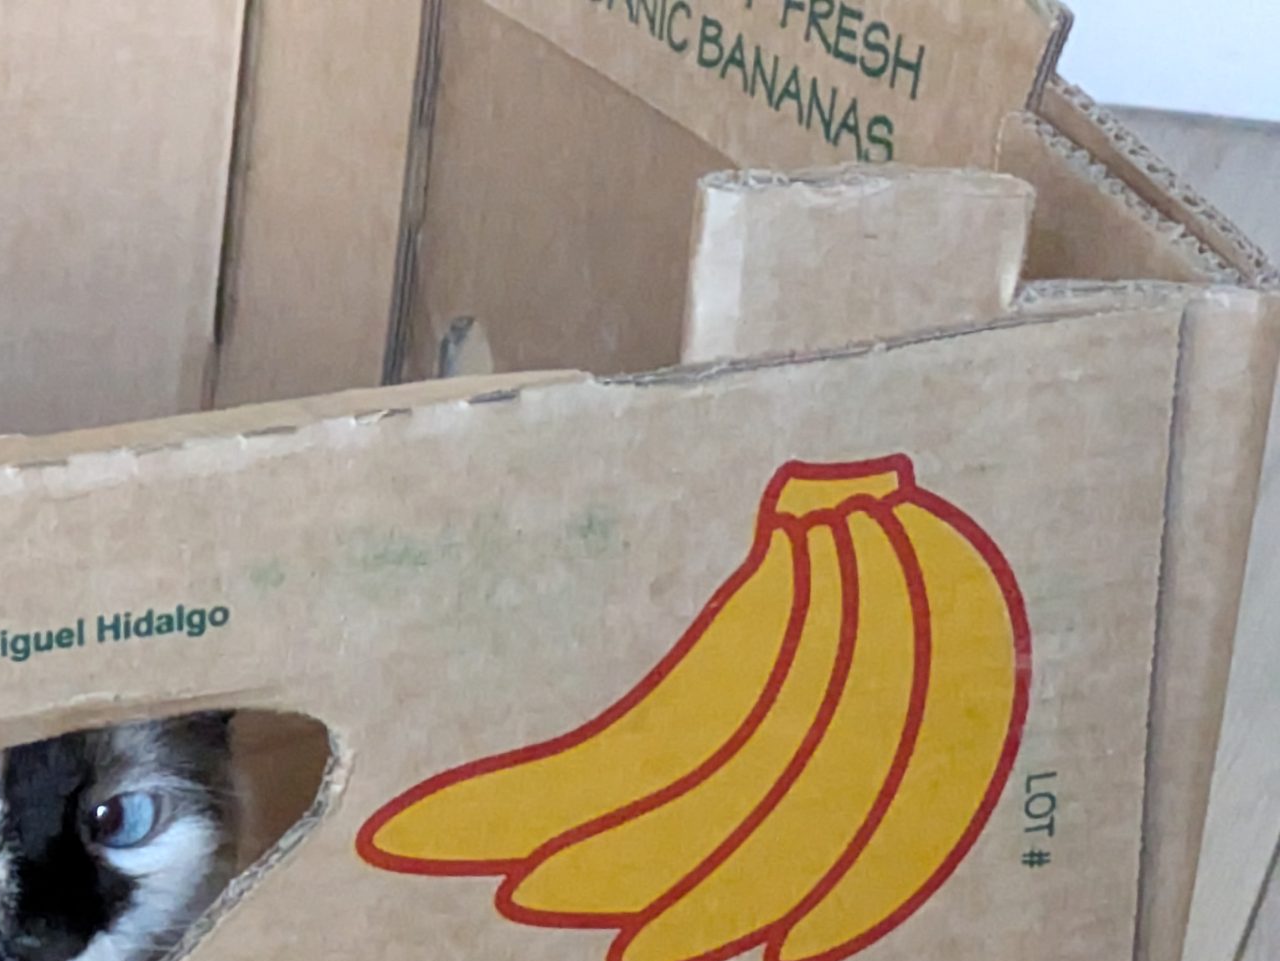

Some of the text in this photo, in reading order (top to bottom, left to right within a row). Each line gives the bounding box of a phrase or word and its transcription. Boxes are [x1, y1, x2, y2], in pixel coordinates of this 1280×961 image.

[697, 14, 894, 163] BANANAS
[96, 602, 231, 644] Hidalgo
[1021, 771, 1058, 869] LOT #
